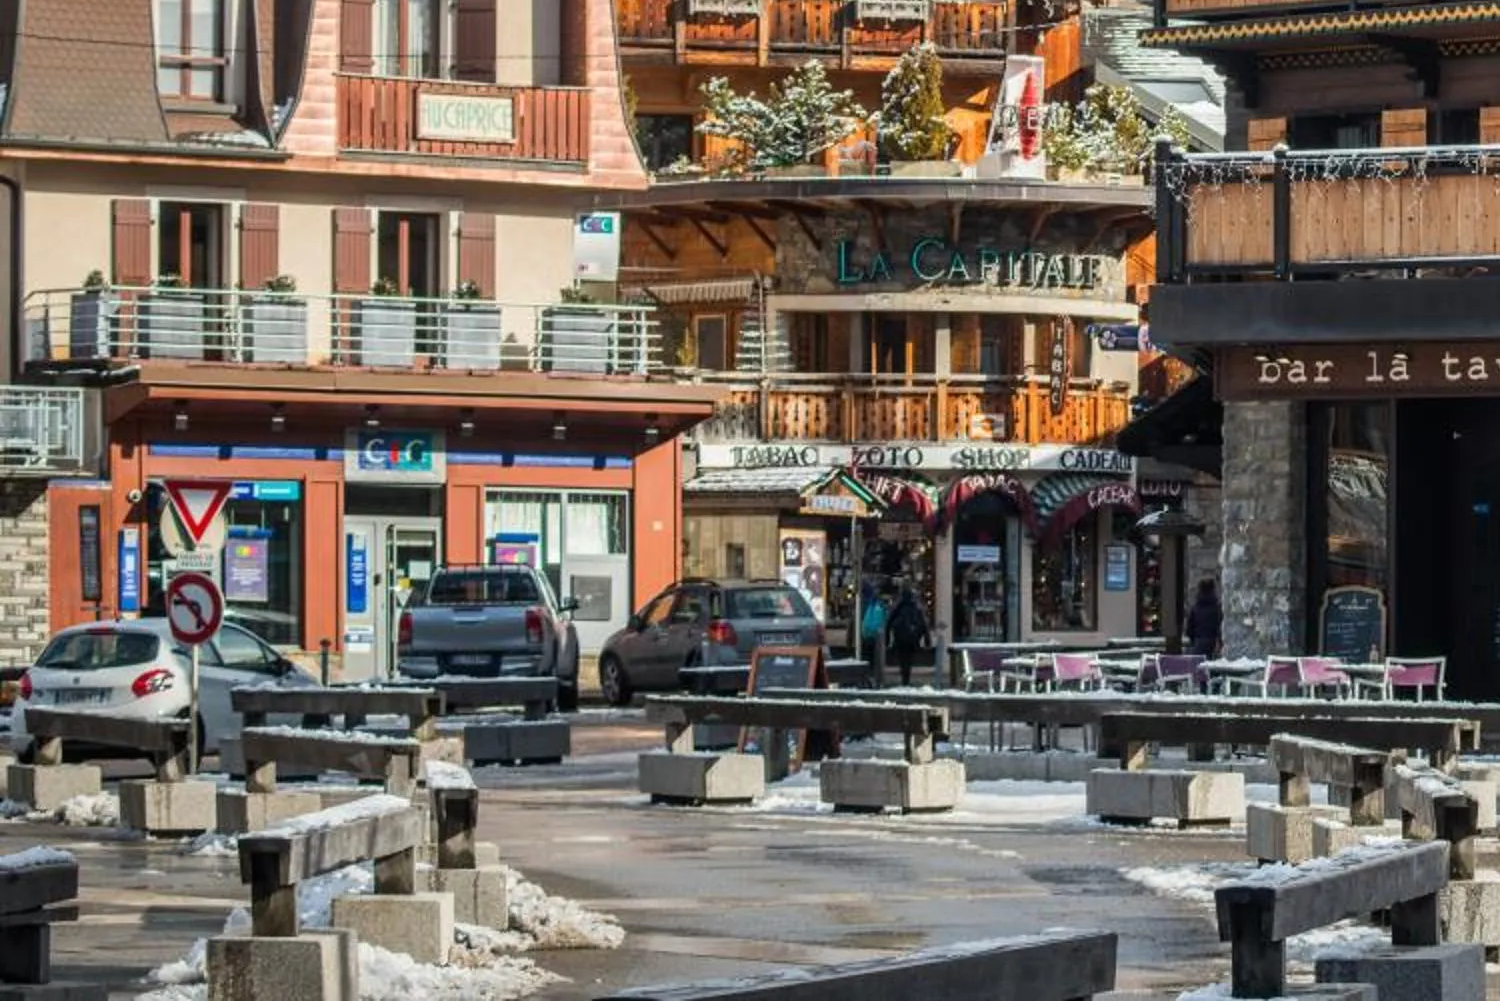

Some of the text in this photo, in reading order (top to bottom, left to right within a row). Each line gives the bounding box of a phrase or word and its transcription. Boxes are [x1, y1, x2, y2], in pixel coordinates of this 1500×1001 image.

[1259, 355, 1334, 383] bar
[1366, 351, 1410, 382] la
[365, 438, 427, 464] CIC
[730, 446, 818, 467] TABAC
